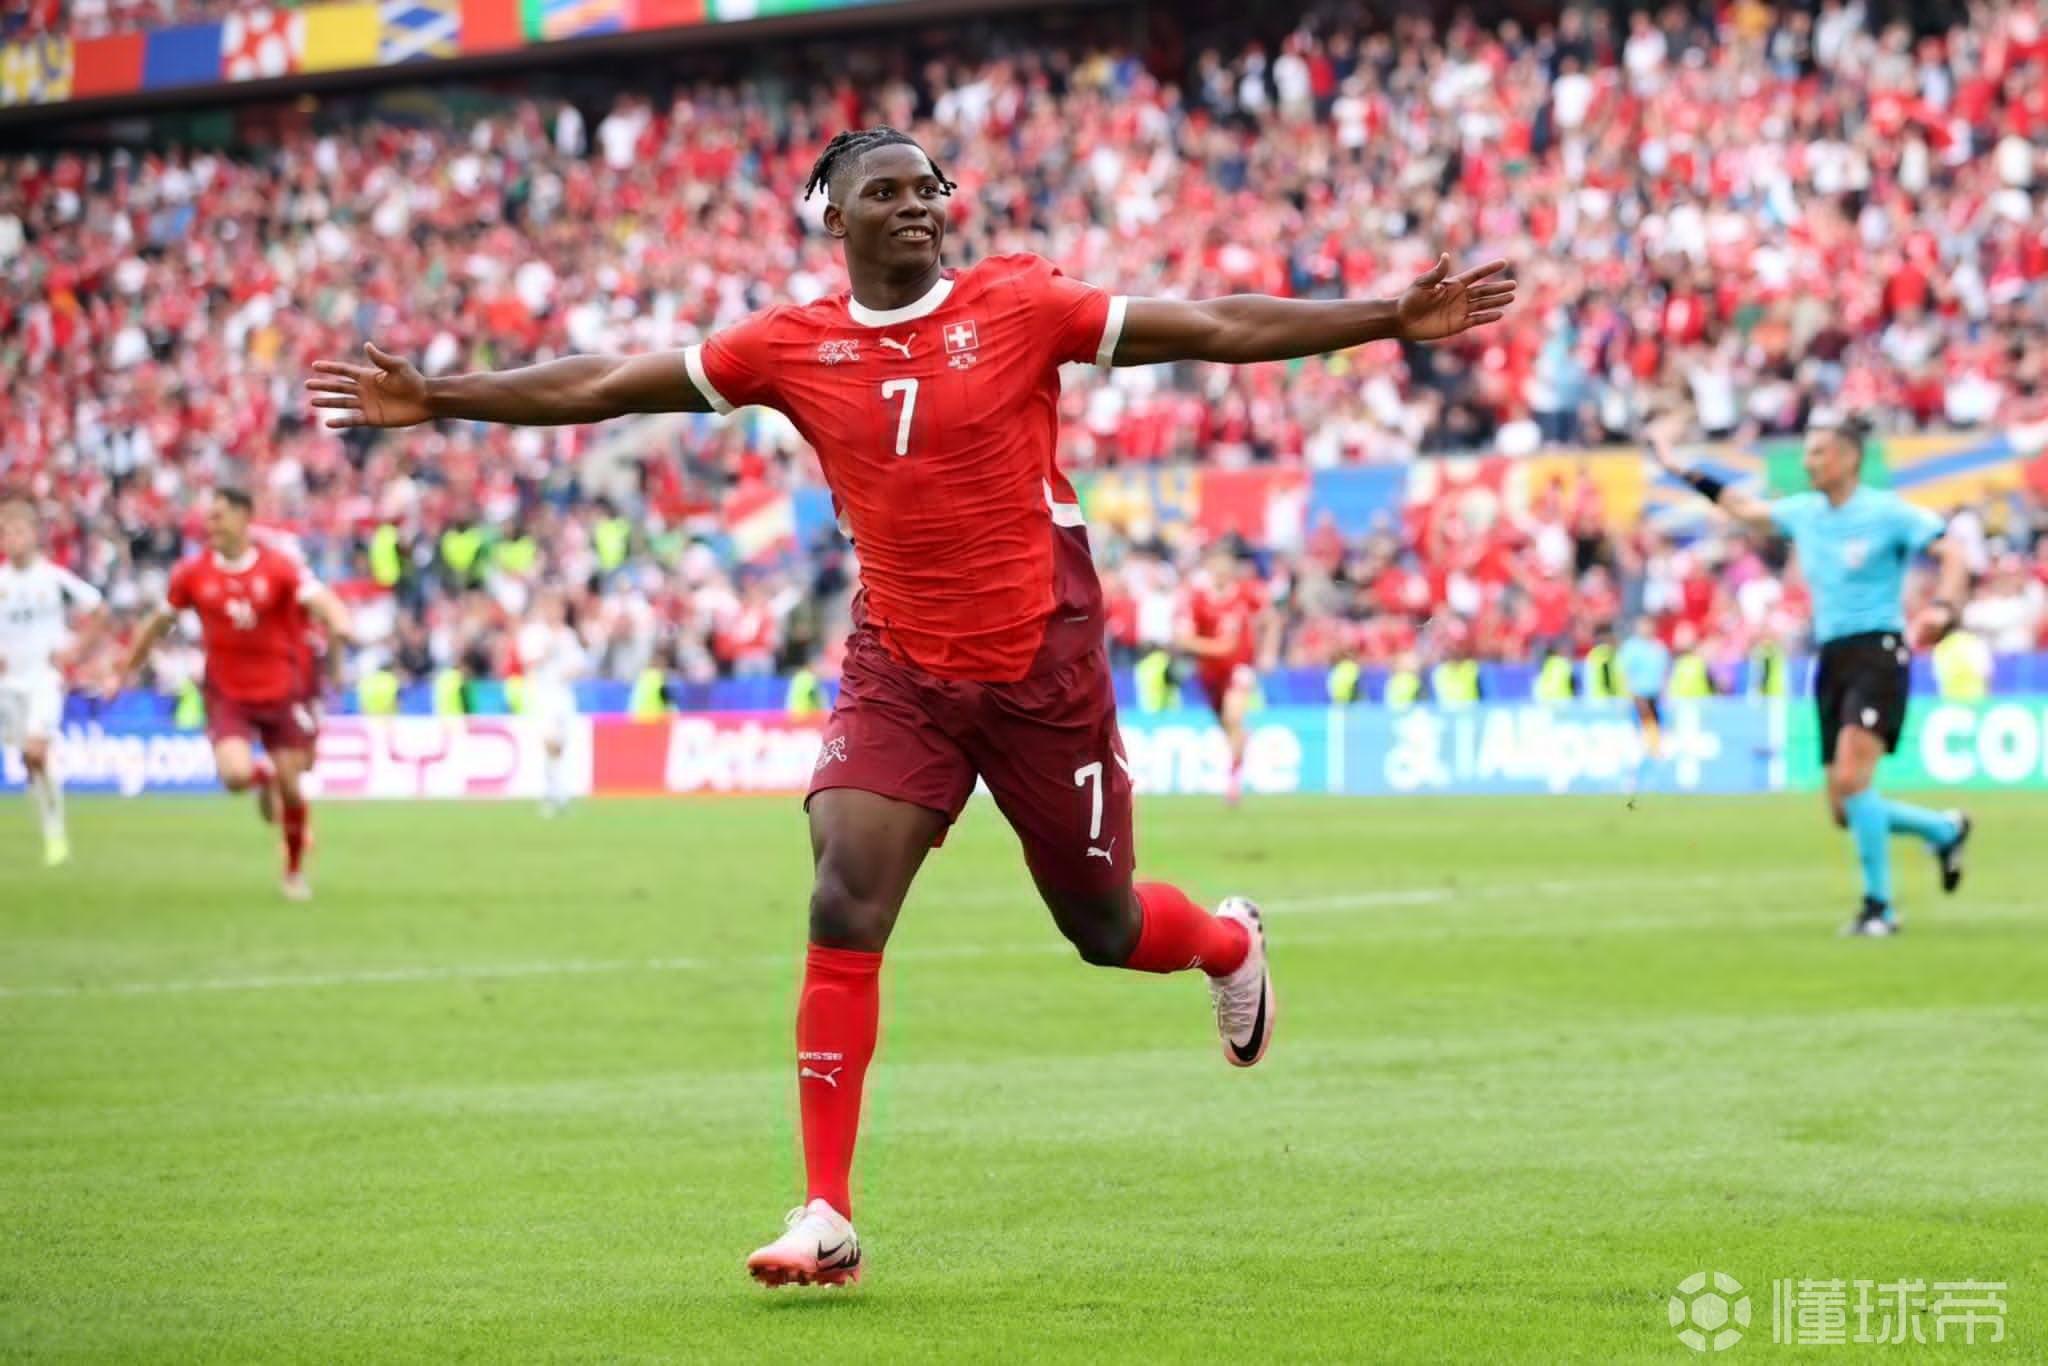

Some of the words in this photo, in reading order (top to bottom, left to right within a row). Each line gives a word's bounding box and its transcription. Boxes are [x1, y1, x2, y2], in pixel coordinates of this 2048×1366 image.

[882, 378, 919, 456] 7
[1920, 703, 2048, 783] CO
[1074, 761, 1103, 840] 7
